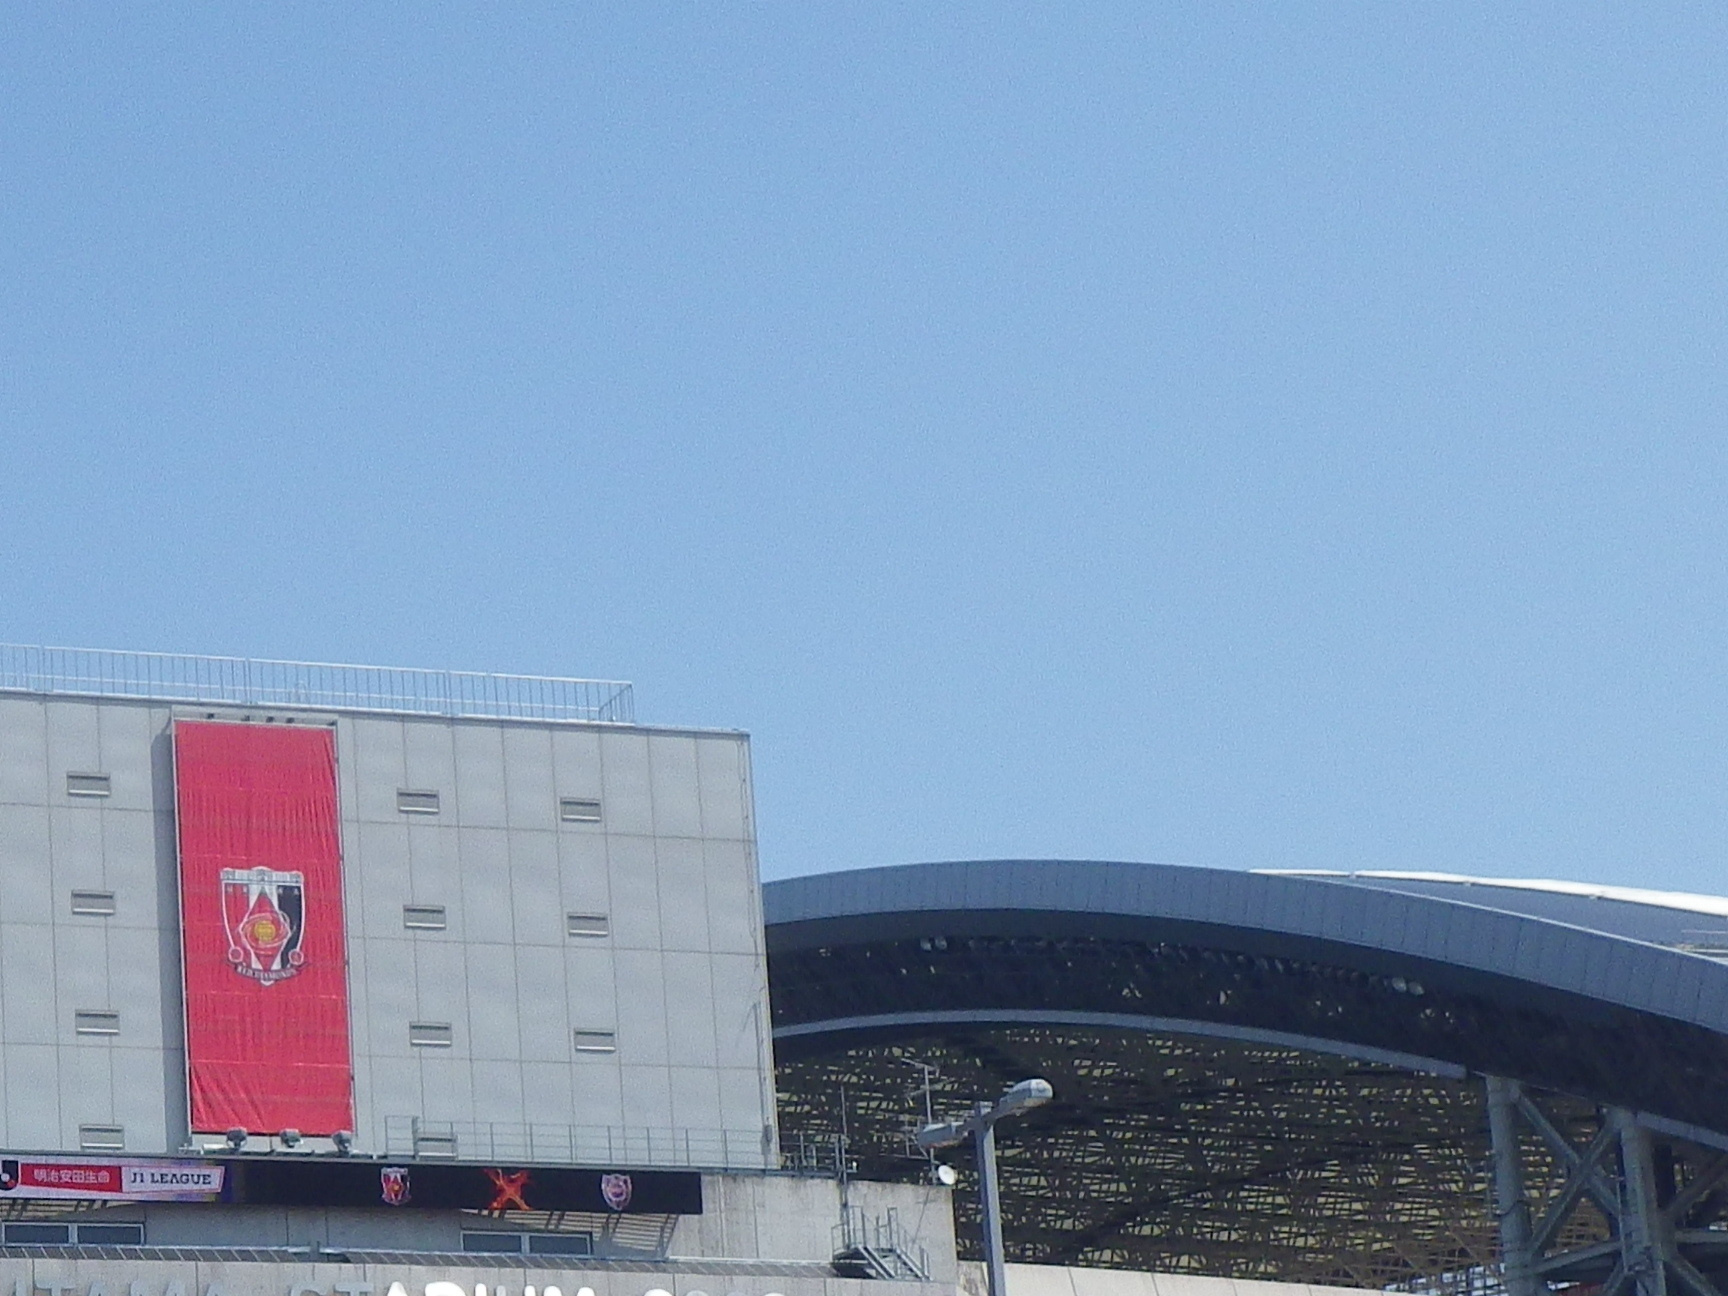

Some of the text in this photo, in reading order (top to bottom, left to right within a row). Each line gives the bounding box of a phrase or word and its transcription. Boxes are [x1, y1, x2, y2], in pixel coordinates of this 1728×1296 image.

[34, 1168, 110, 1184] 明治安田生命
[131, 1172, 212, 1185] J1 LEAGUE
